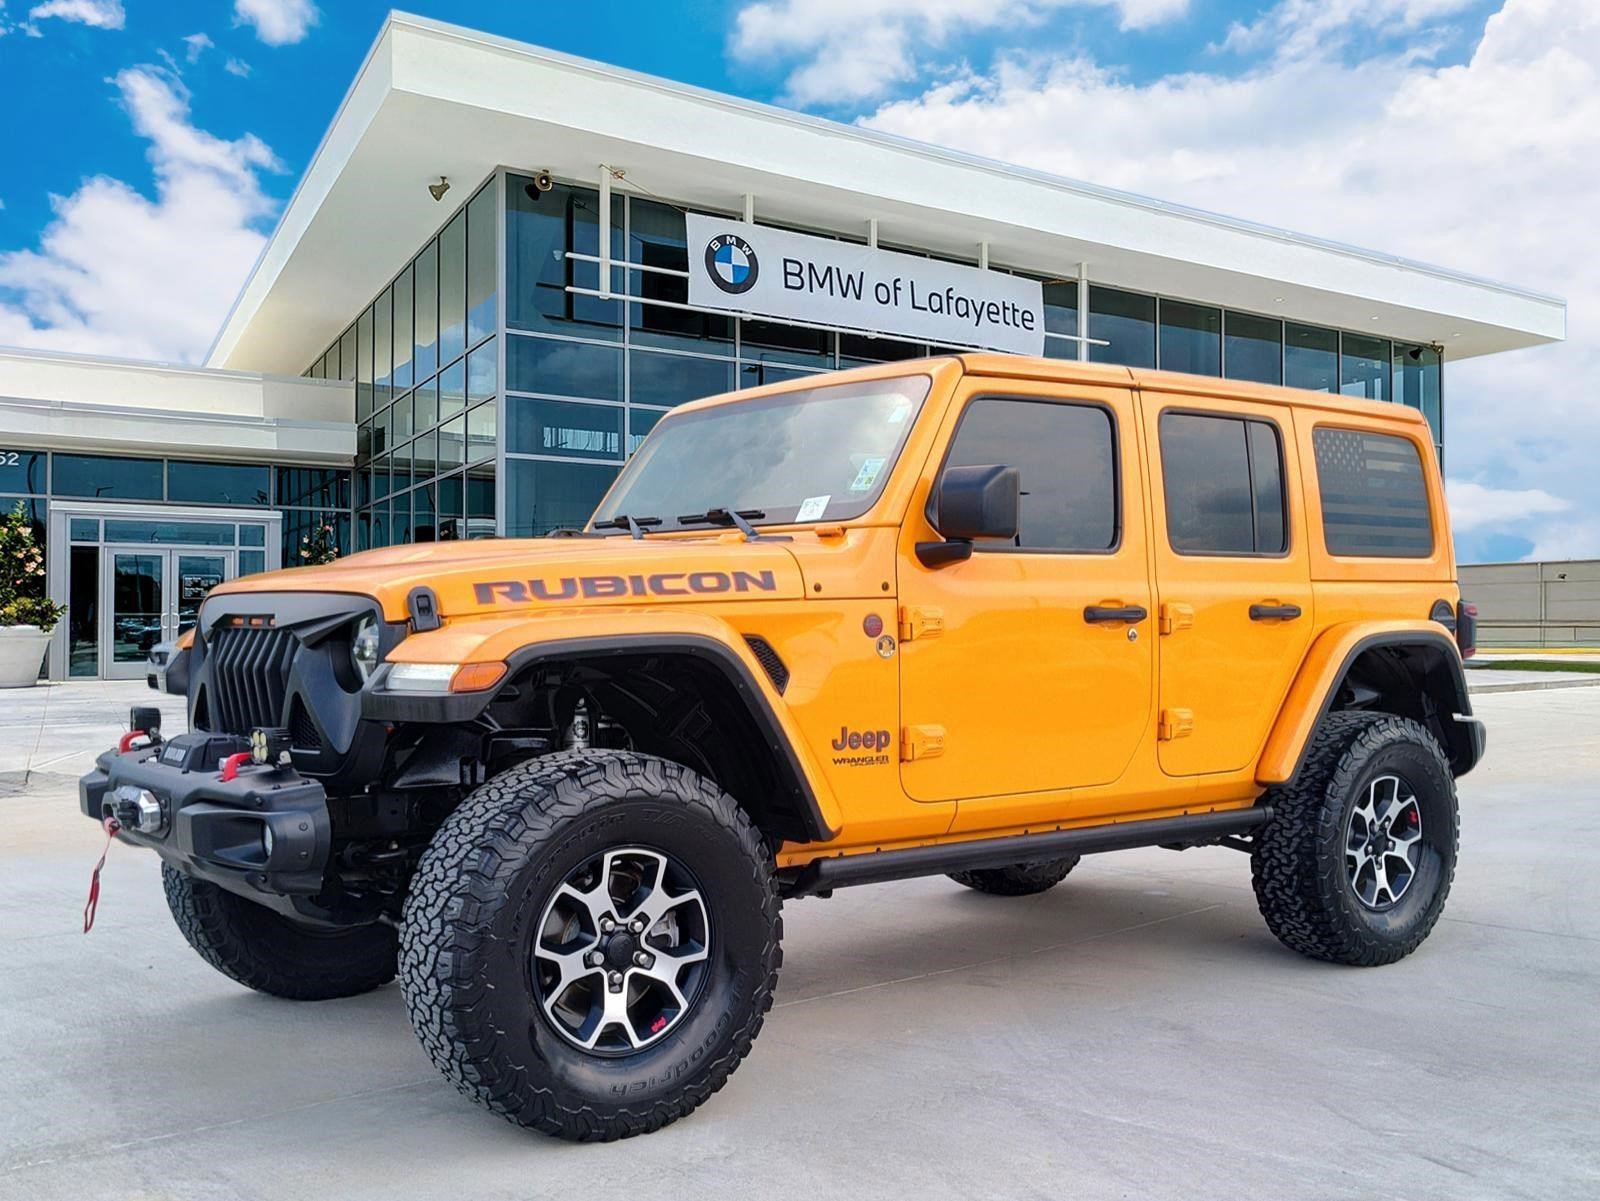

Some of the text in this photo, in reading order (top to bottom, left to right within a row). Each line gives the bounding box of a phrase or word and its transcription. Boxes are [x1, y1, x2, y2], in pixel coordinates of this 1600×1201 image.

[710, 235, 753, 256] BMW
[783, 257, 1035, 331] BMW of Lafayette
[473, 570, 777, 605] RUBICON
[831, 726, 891, 752] Jeep
[832, 755, 889, 765] WRANGLER
